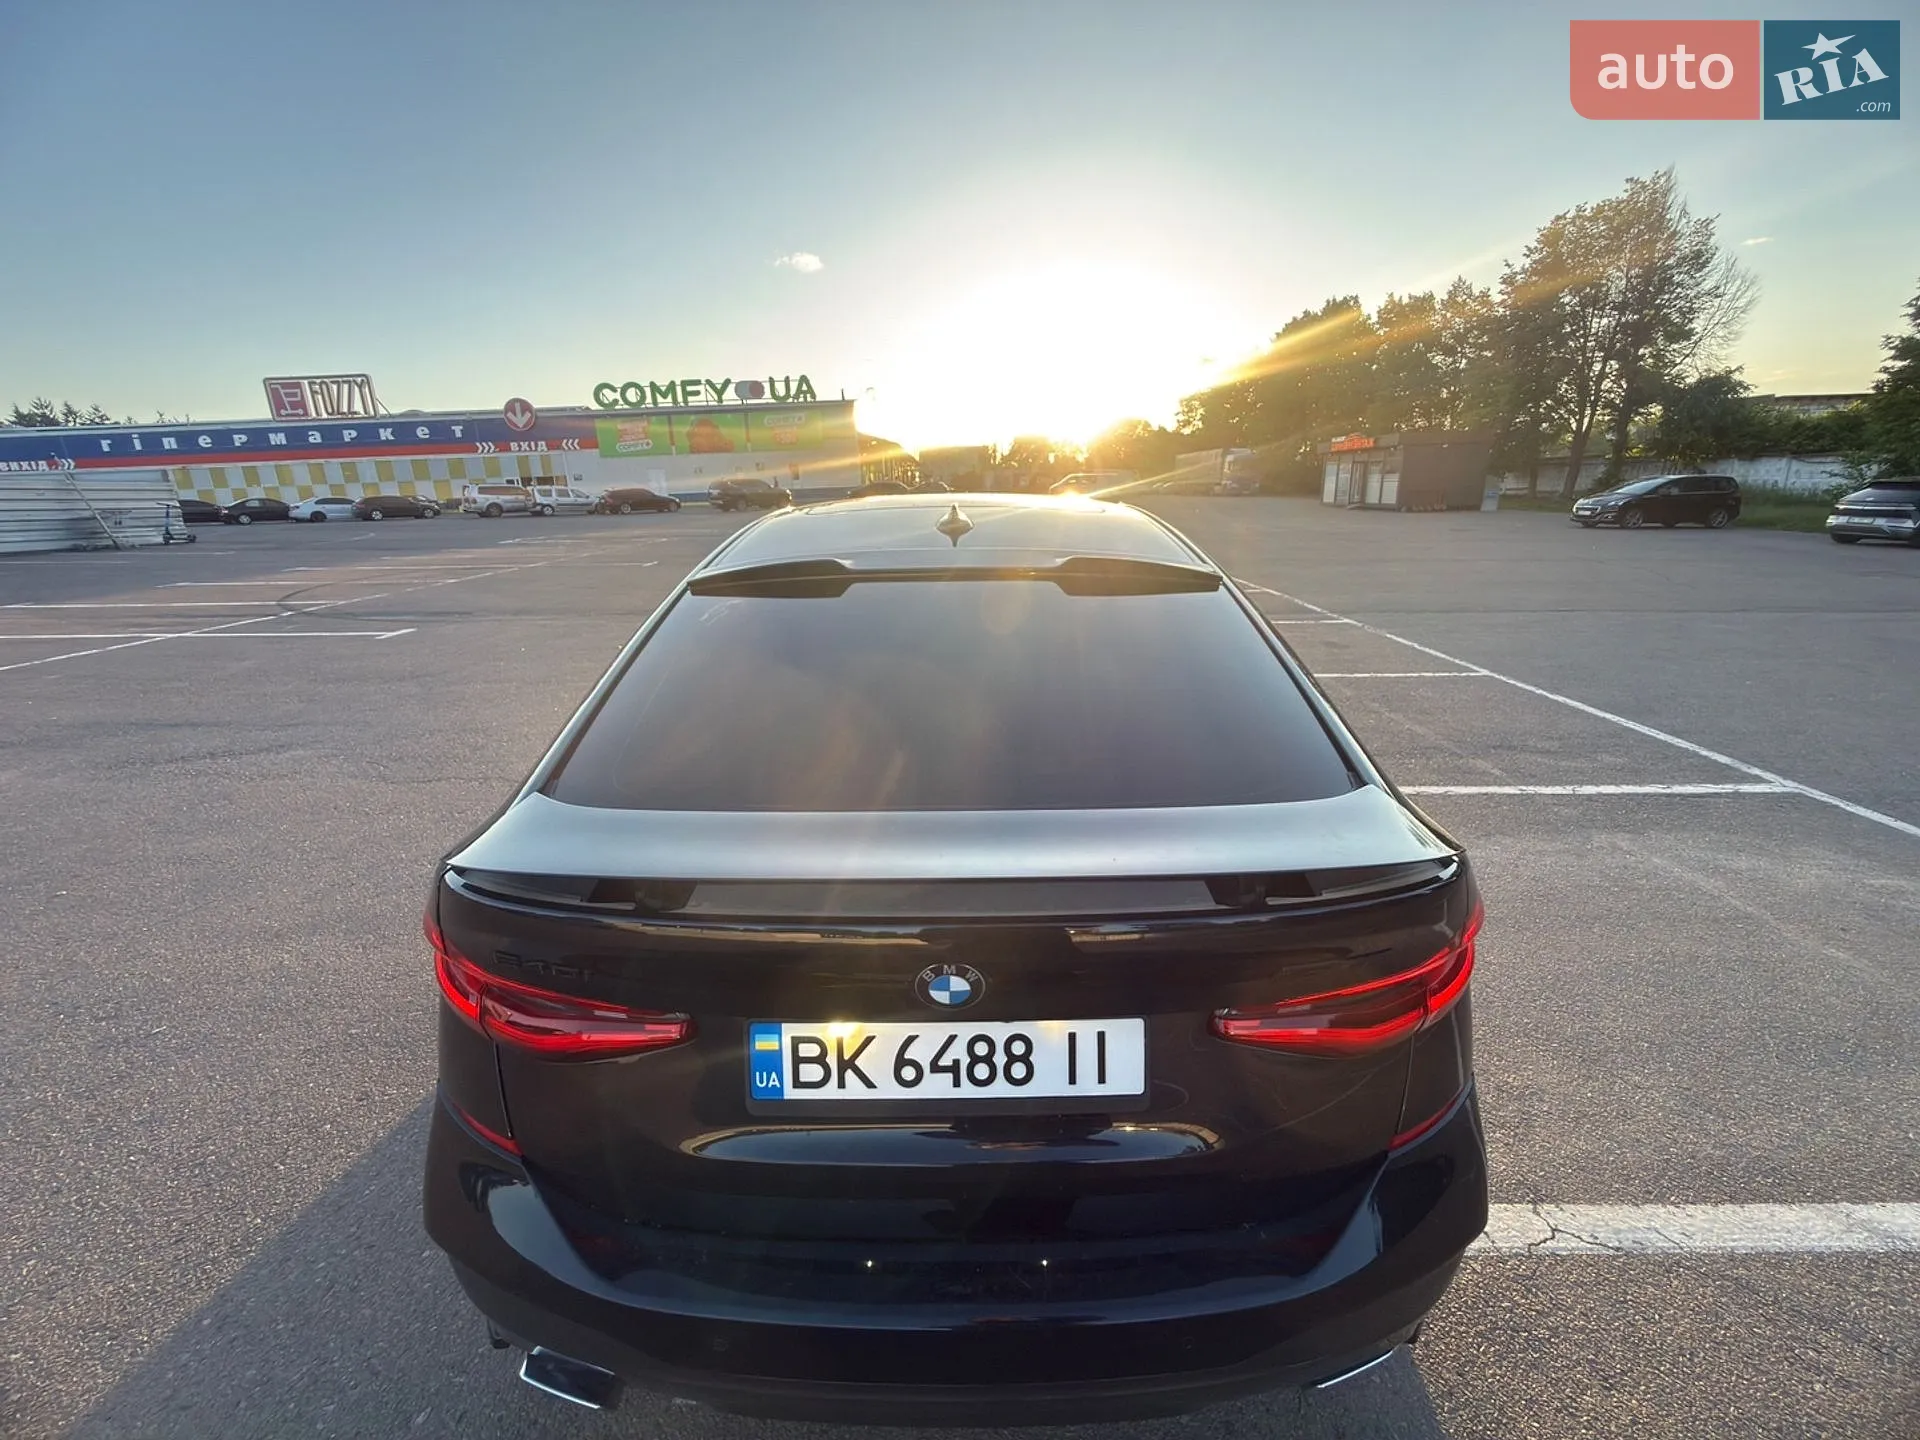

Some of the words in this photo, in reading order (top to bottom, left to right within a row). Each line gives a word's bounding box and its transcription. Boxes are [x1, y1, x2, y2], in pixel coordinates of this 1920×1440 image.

[307, 376, 368, 417] FOZZY
[593, 377, 731, 410] COMFY
[768, 375, 817, 403] UA
[922, 964, 979, 982] BMW
[790, 1034, 878, 1090] BK
[893, 1032, 1035, 1089] 6488
[1067, 1030, 1107, 1086] II
[755, 1070, 781, 1089] UA
